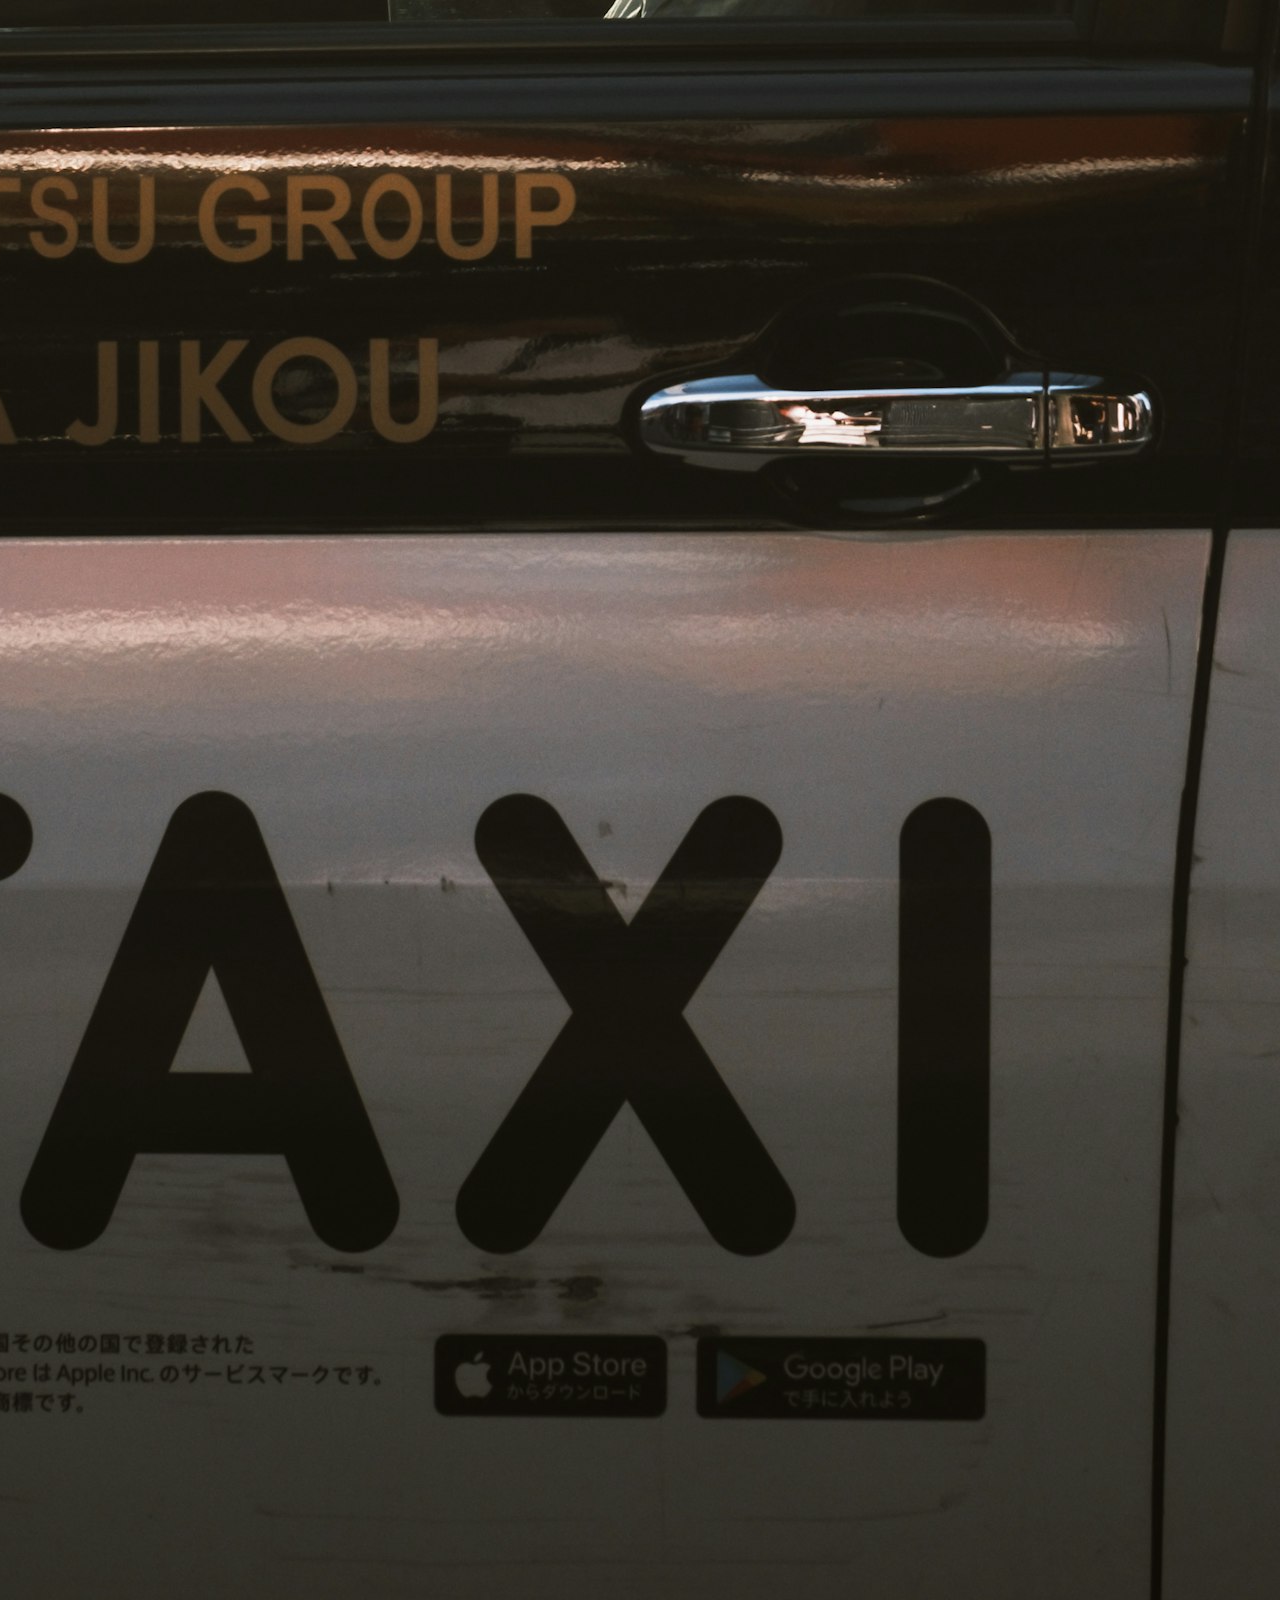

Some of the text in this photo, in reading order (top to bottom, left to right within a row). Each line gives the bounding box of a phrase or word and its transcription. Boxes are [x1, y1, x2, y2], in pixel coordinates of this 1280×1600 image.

[197, 172, 578, 263] GROUP
[66, 337, 440, 446] JIKOU
[56, 1364, 115, 1387] Apple
[120, 1364, 154, 1383] Inc.
[507, 1352, 647, 1380] App Store
[783, 1353, 945, 1387] Google Play
[506, 1384, 642, 1402] からダウンロード
[783, 1388, 913, 1410] で手に入れよう
